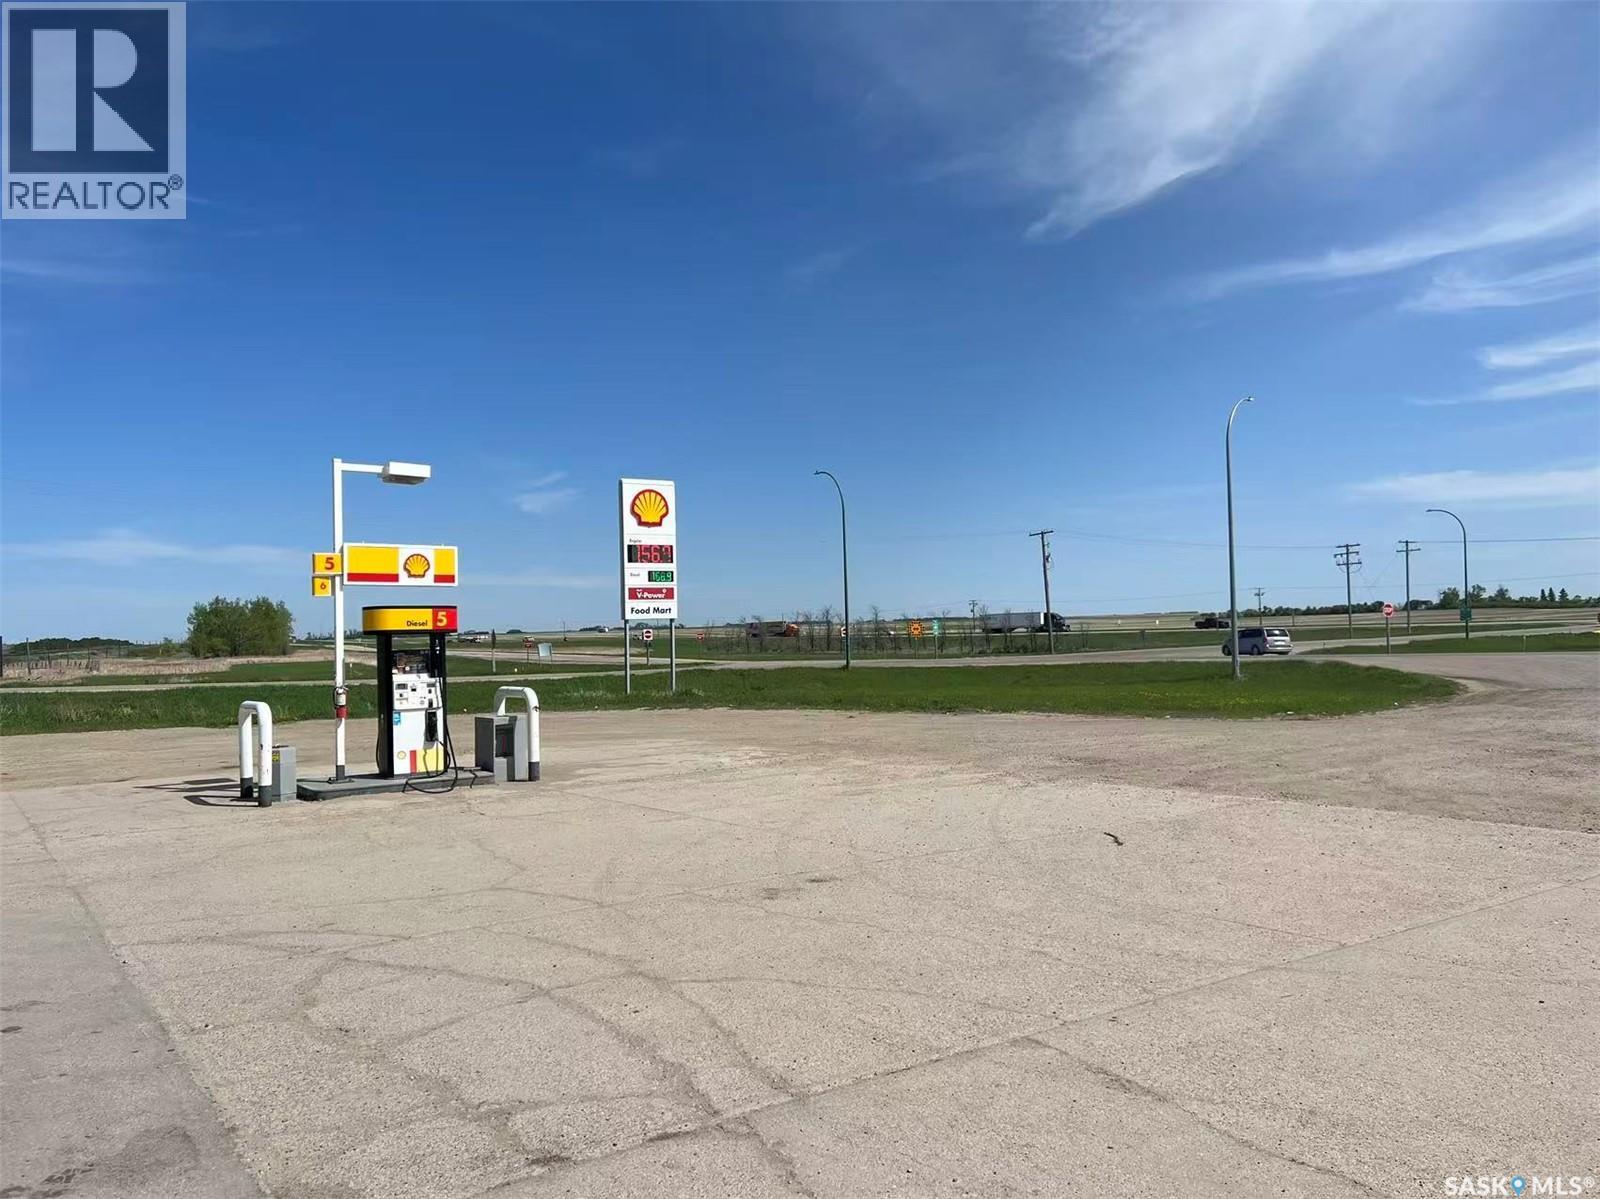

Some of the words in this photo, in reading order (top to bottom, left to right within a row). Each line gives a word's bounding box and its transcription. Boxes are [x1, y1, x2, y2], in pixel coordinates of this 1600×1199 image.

[325, 557, 335, 570] 5
[320, 582, 327, 590] 6
[653, 606, 671, 614] Mart
[436, 611, 447, 626] 5
